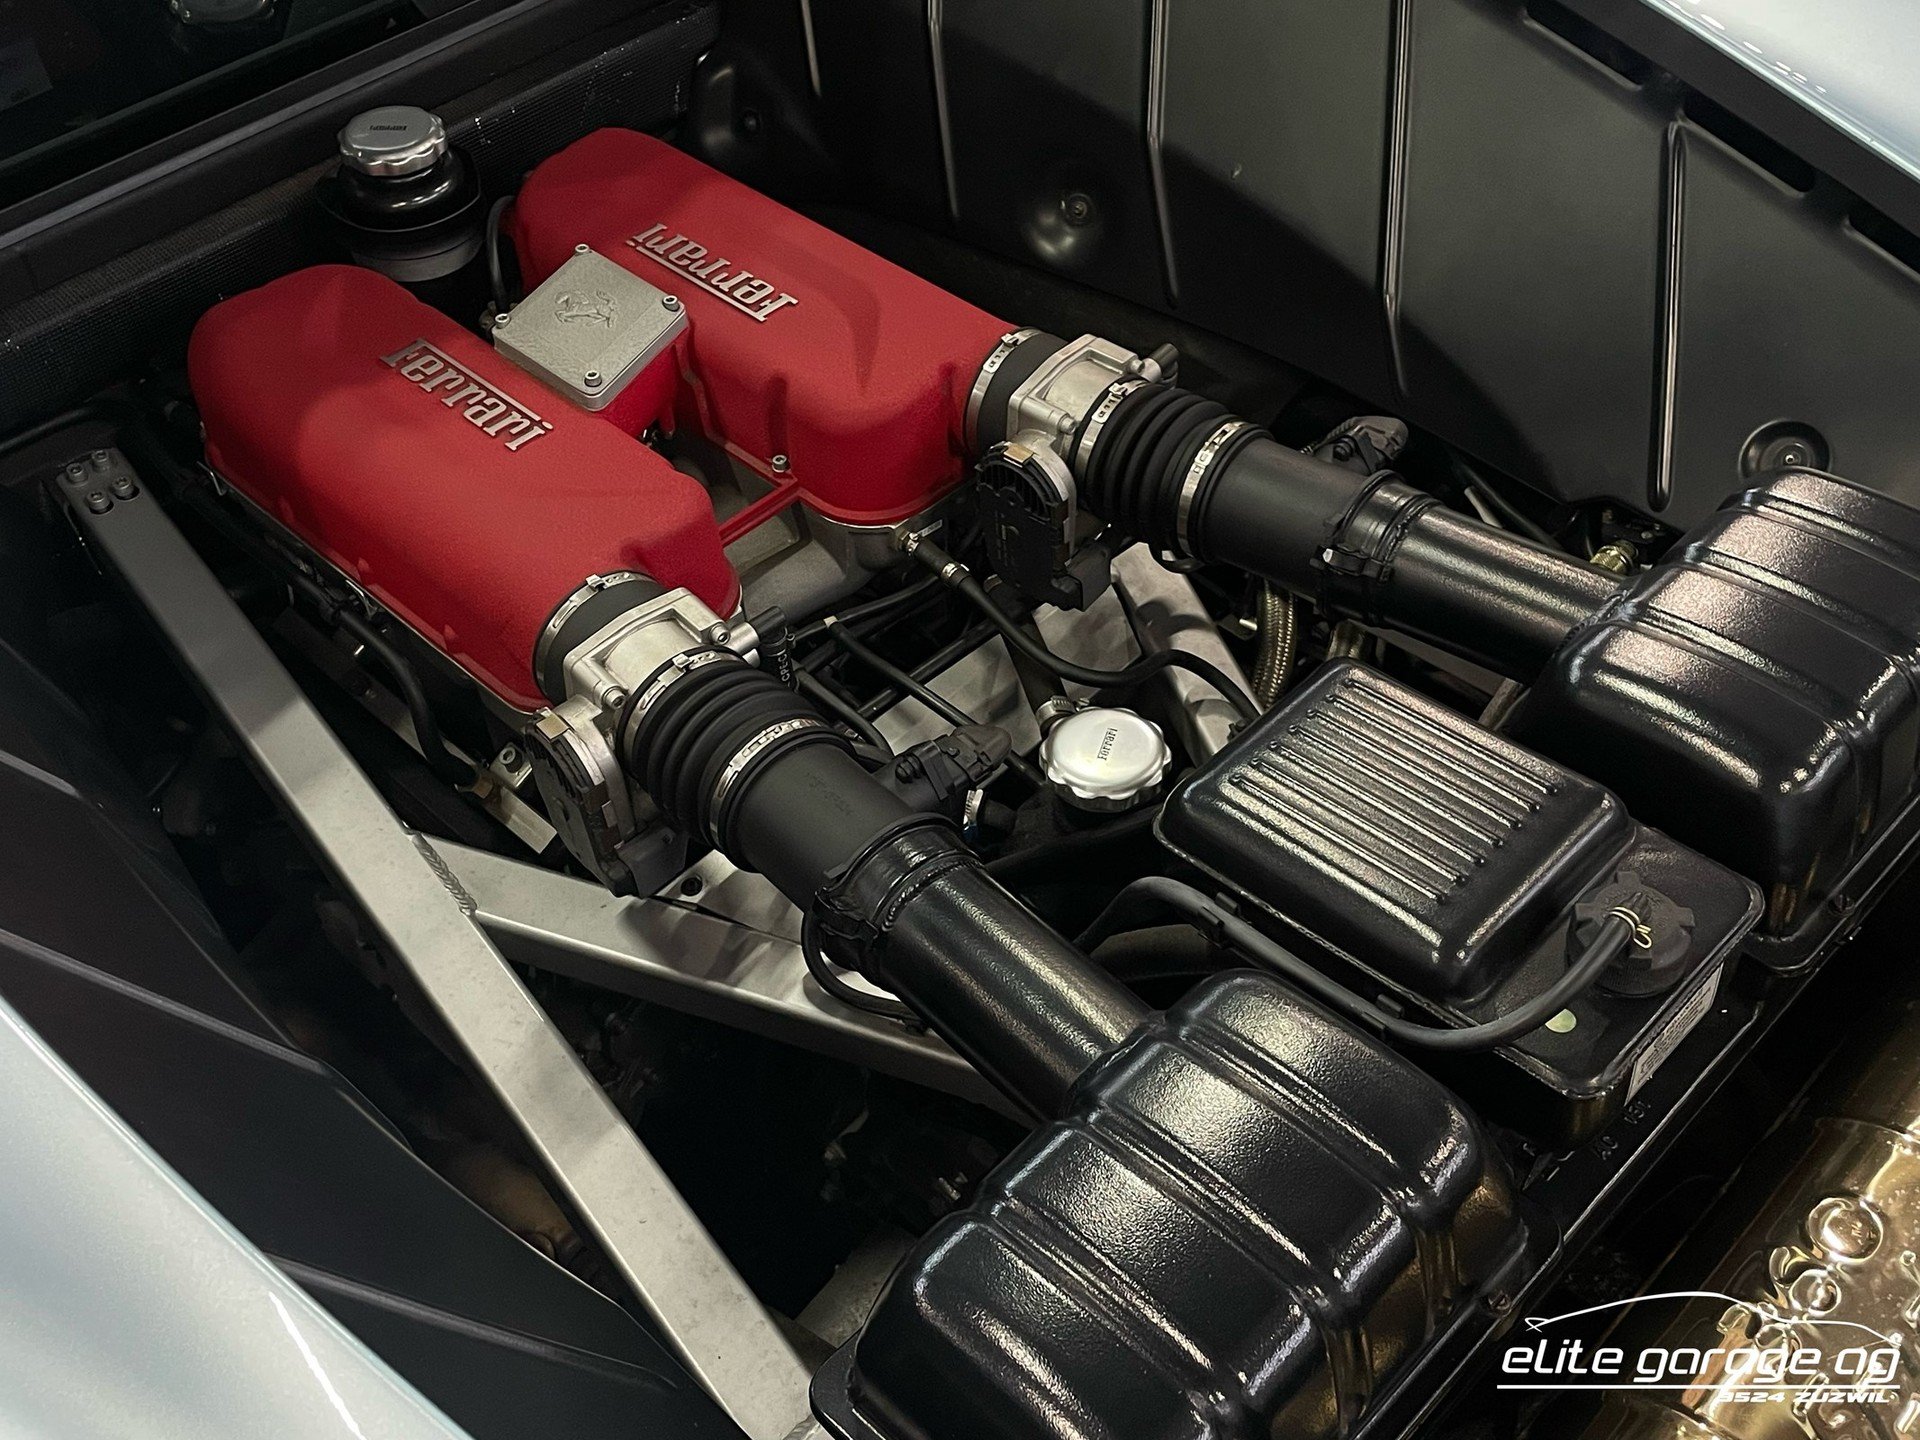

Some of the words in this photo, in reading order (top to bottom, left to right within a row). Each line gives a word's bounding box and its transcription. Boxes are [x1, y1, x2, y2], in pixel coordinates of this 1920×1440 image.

[625, 222, 799, 323] Ferrari
[379, 337, 554, 451] Ferrari
[1097, 727, 1118, 761] Ferrari
